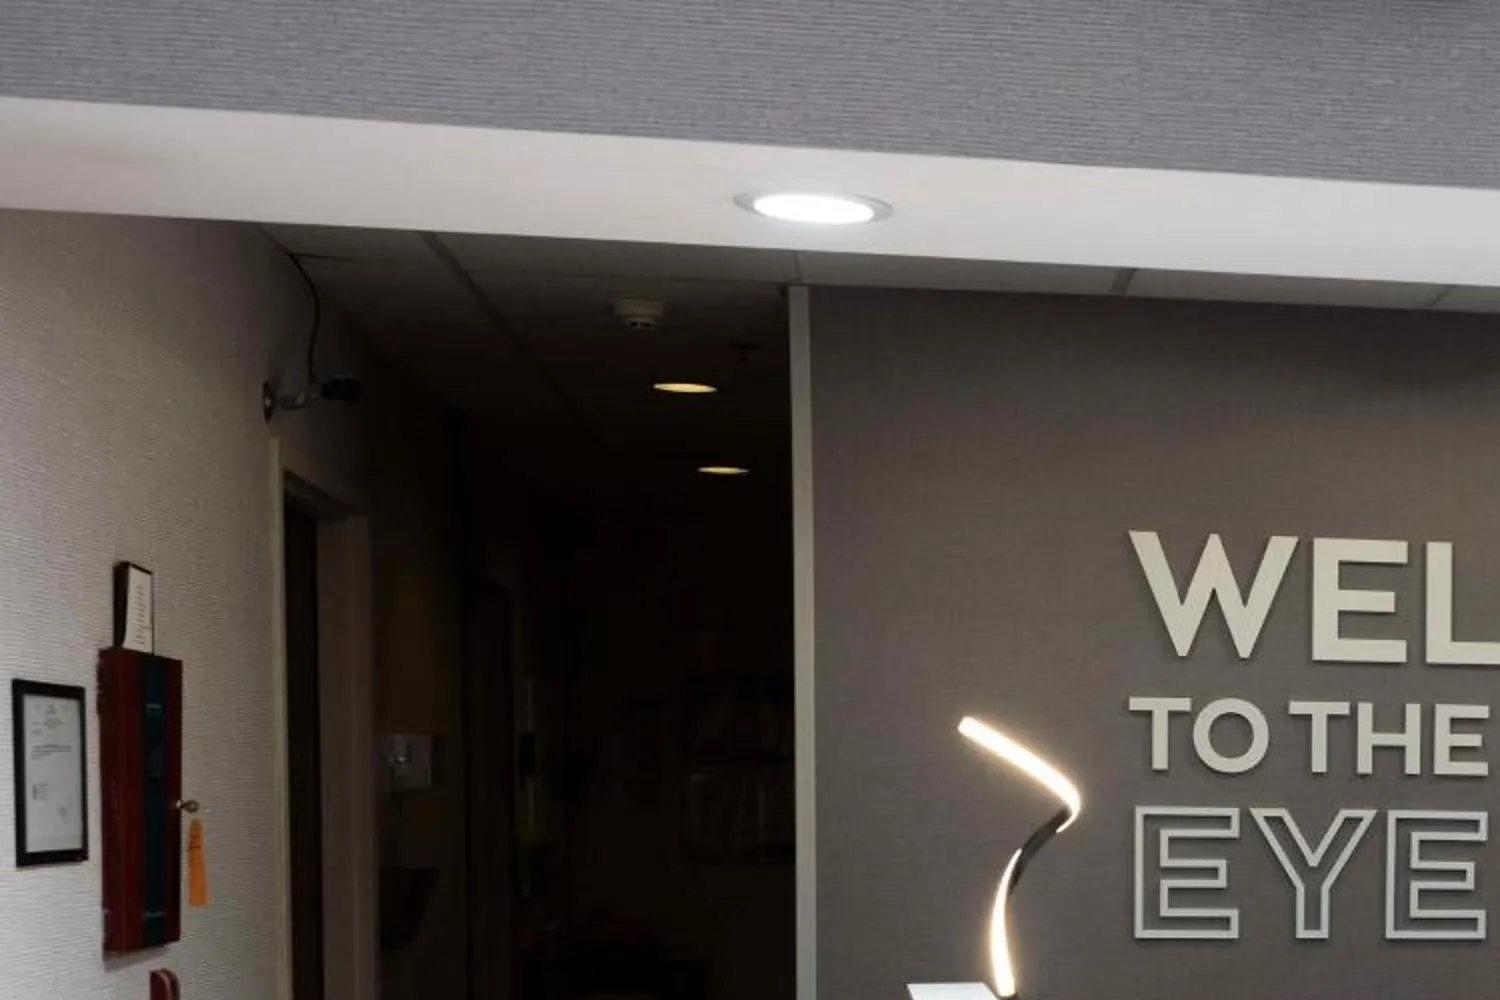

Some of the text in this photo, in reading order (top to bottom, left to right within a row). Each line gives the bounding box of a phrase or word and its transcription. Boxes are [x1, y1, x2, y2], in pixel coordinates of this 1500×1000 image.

[1129, 696, 1269, 773] TO
[1288, 700, 1490, 776] THE
[1134, 806, 1489, 940] EYE
